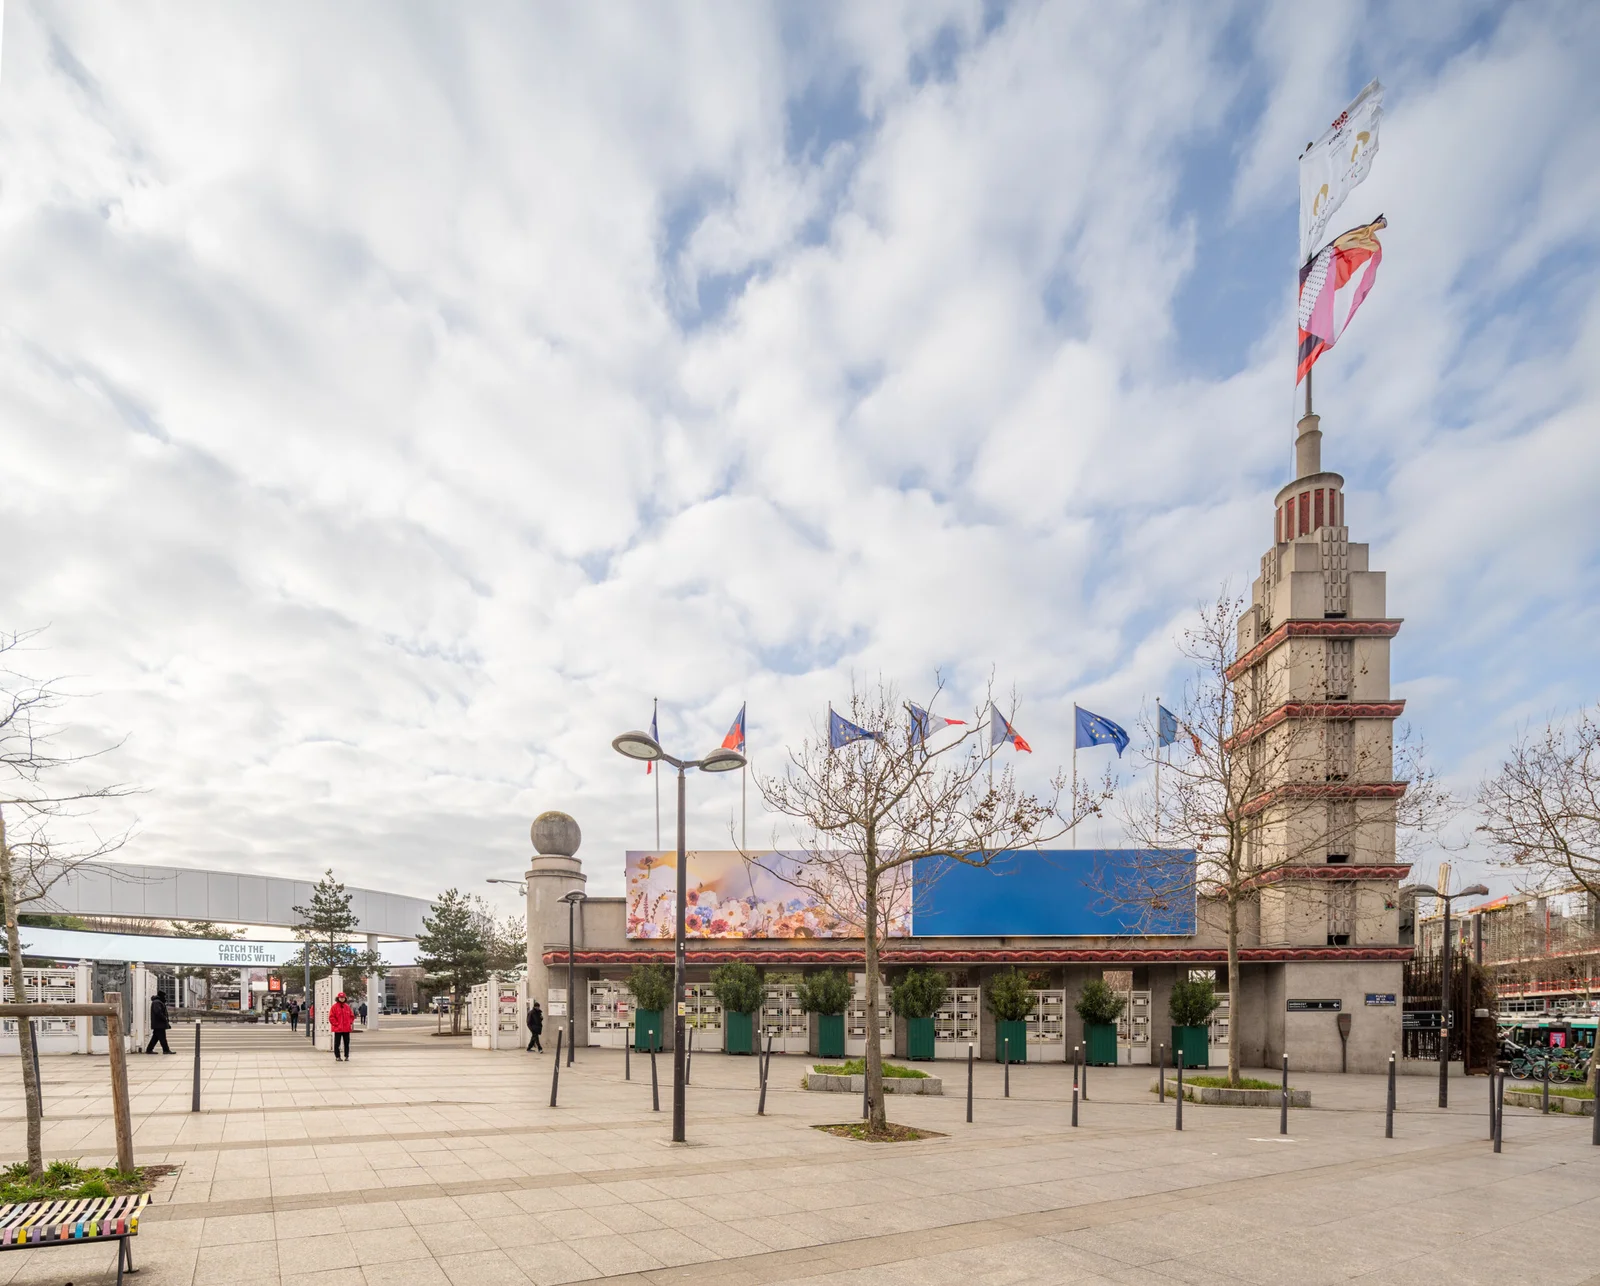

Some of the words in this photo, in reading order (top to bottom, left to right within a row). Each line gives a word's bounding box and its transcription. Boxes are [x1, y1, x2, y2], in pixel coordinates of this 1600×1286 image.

[218, 944, 246, 953] CATCH
[248, 945, 264, 954] THE
[218, 953, 252, 962] TRENDS
[254, 954, 276, 963] WITH
